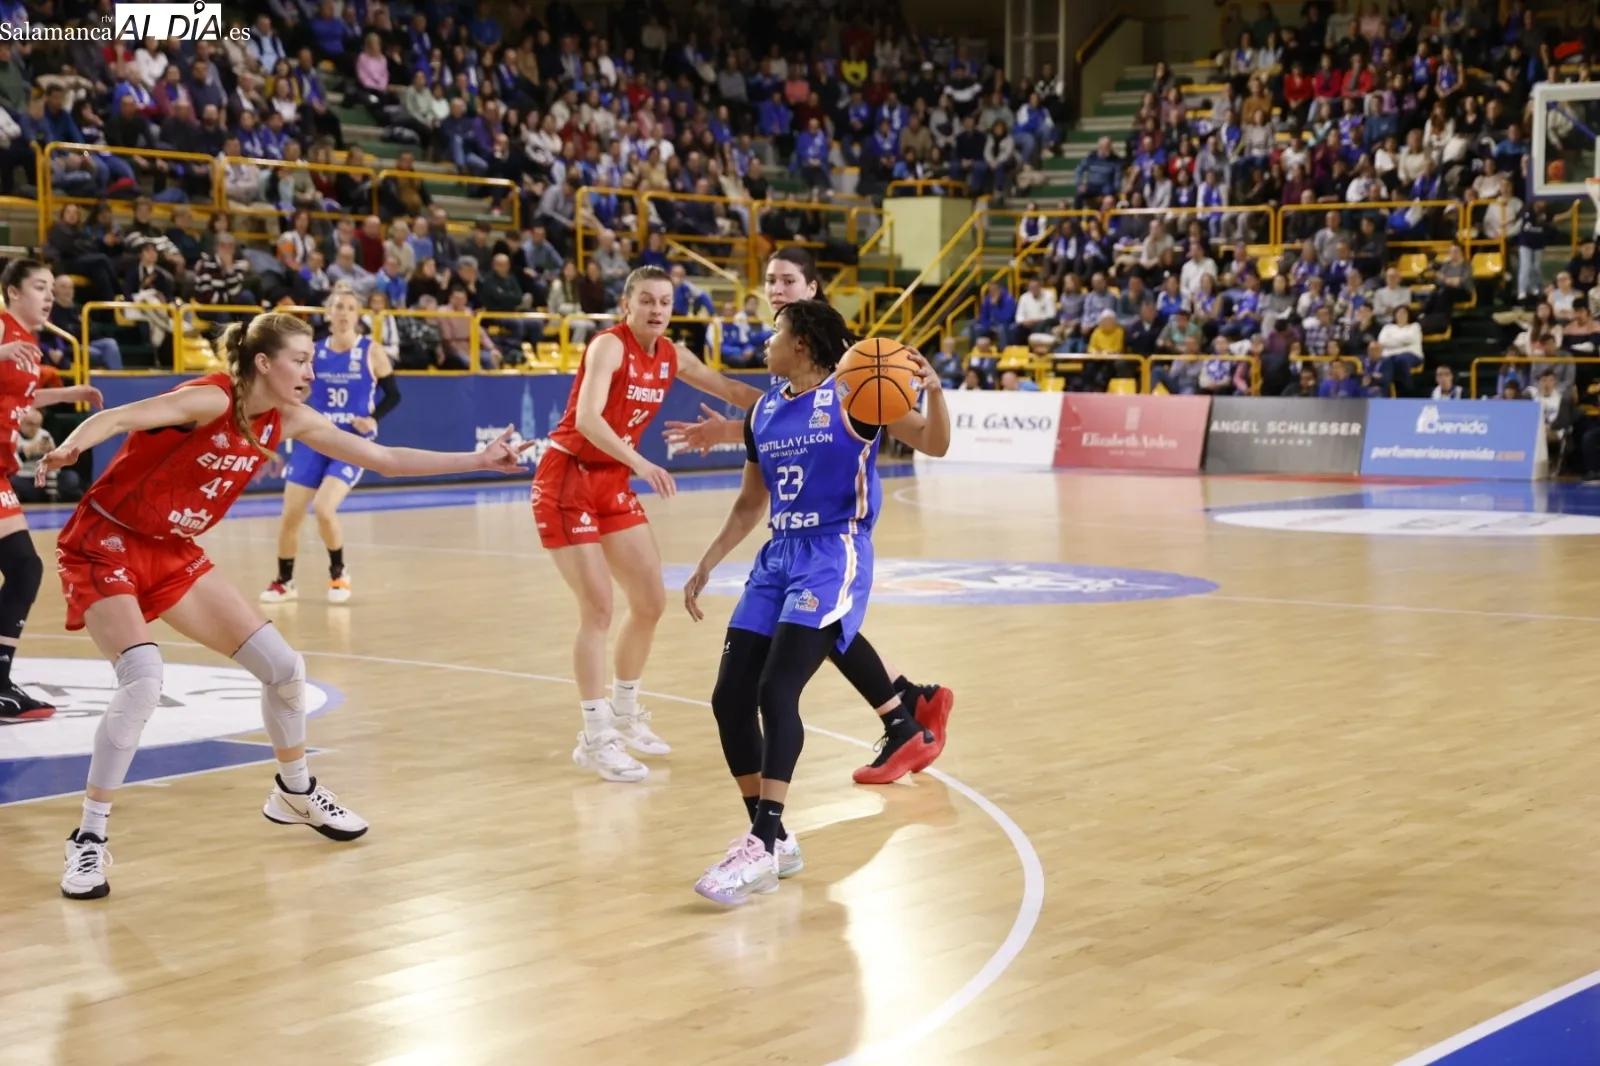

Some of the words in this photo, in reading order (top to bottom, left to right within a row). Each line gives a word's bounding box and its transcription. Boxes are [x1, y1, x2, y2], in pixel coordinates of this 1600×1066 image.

[327, 387, 348, 408] 30
[956, 413, 976, 429] EL
[983, 413, 1052, 432] GANSO
[1210, 419, 1261, 434] ANGEL
[1266, 420, 1362, 437] SCHLESSER
[759, 438, 795, 453] CASTILLA
[795, 435, 803, 447] Y
[803, 431, 833, 445] LEÓN
[777, 465, 804, 501] 23
